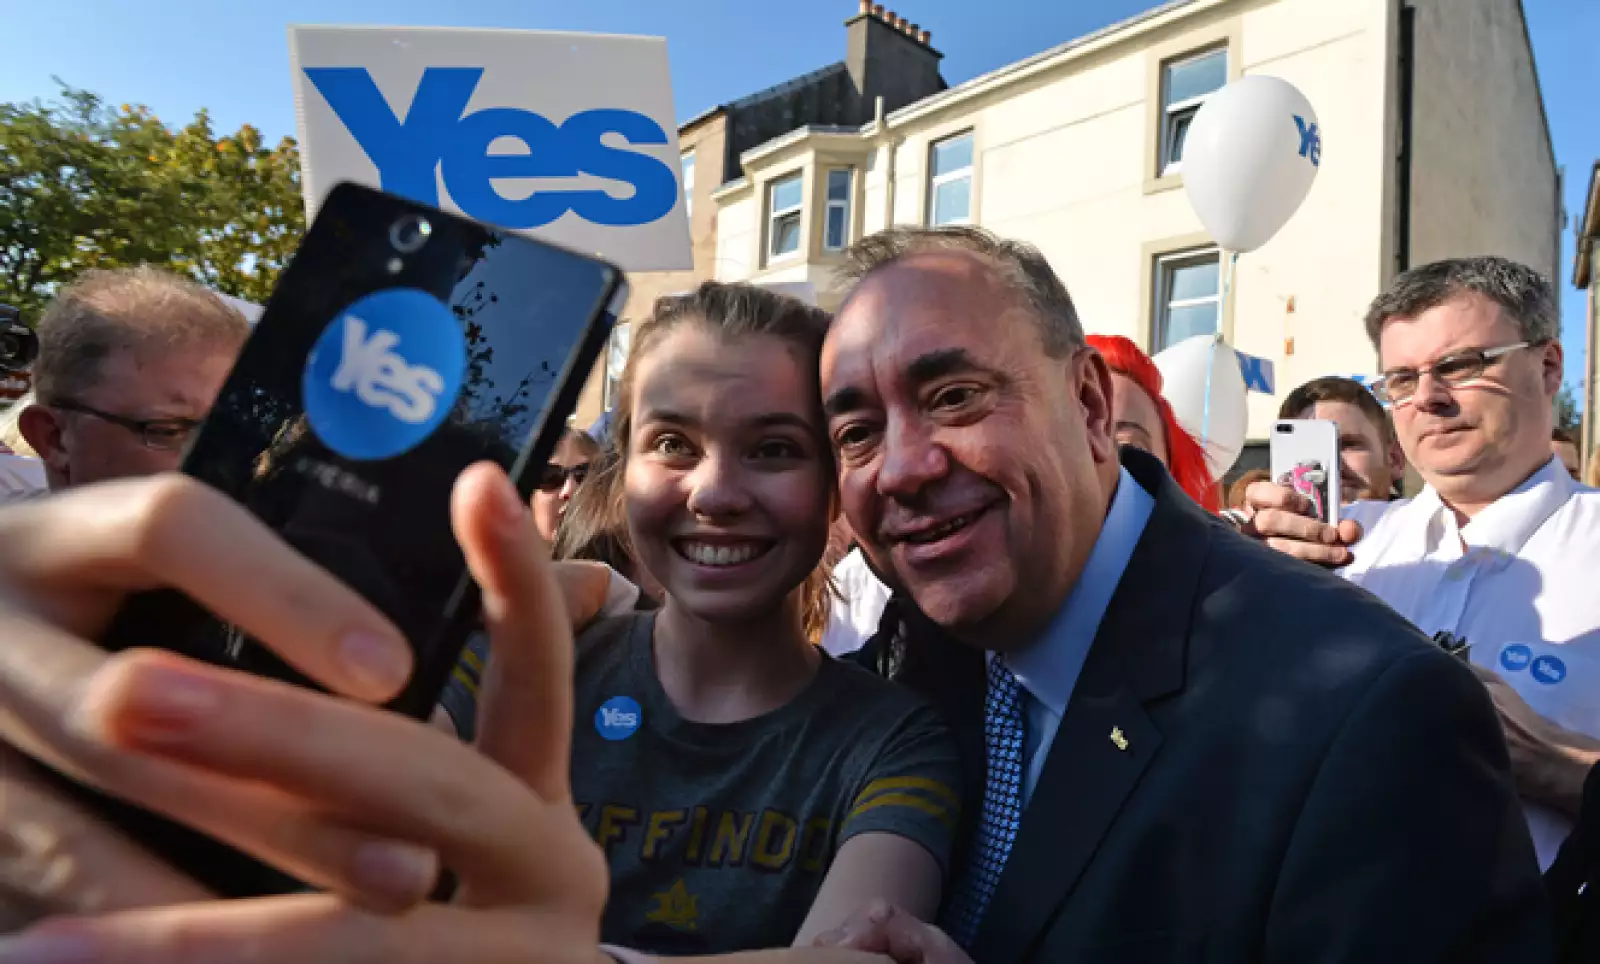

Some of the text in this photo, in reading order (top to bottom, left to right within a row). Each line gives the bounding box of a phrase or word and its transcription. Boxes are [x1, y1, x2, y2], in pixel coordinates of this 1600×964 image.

[302, 67, 678, 229] Yes
[1292, 114, 1321, 167] Ye
[330, 316, 445, 424] Yes
[601, 707, 637, 726] Yes
[575, 803, 833, 874] FFINDO
